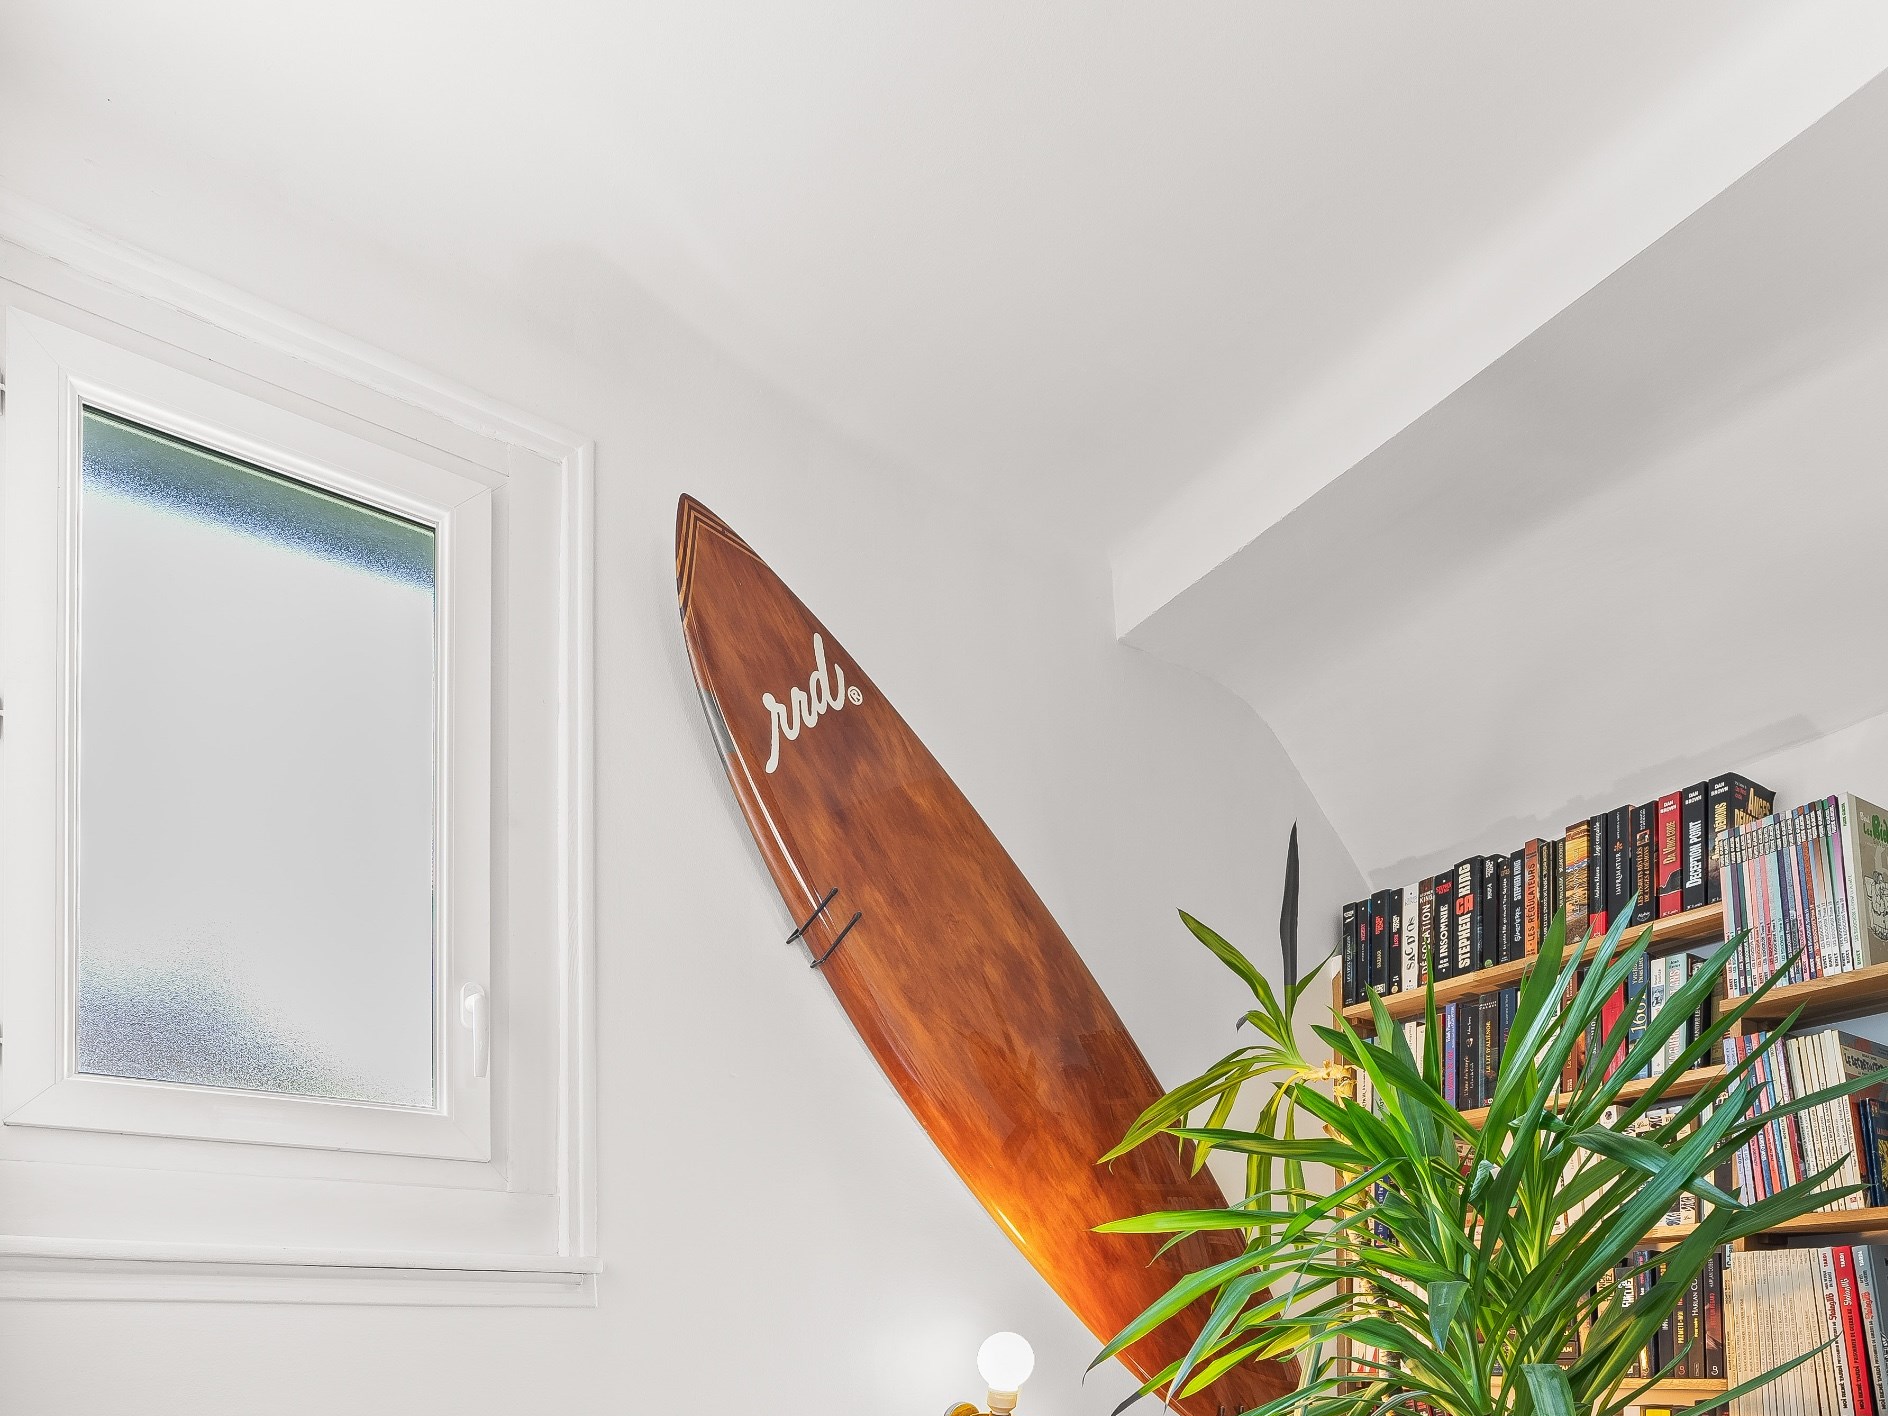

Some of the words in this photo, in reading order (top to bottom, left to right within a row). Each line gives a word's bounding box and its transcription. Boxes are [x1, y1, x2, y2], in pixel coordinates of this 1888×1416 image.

[762, 632, 845, 774] rrd
[1685, 795, 1702, 805] BROWN
[1711, 786, 1728, 797] BROWN
[1660, 804, 1676, 814] BROWN
[1714, 802, 1726, 832] DÉMONS
[1689, 820, 1702, 843] POINT
[1458, 863, 1471, 898] KING
[1685, 843, 1702, 888] DECEPTION
[1526, 863, 1535, 923] RÉGULATEURS
[1440, 904, 1448, 957] INSOMNIE
[1458, 913, 1471, 968] STEPHEN
[1405, 947, 1416, 970] SAC
[1691, 1292, 1699, 1316] HARLAN
